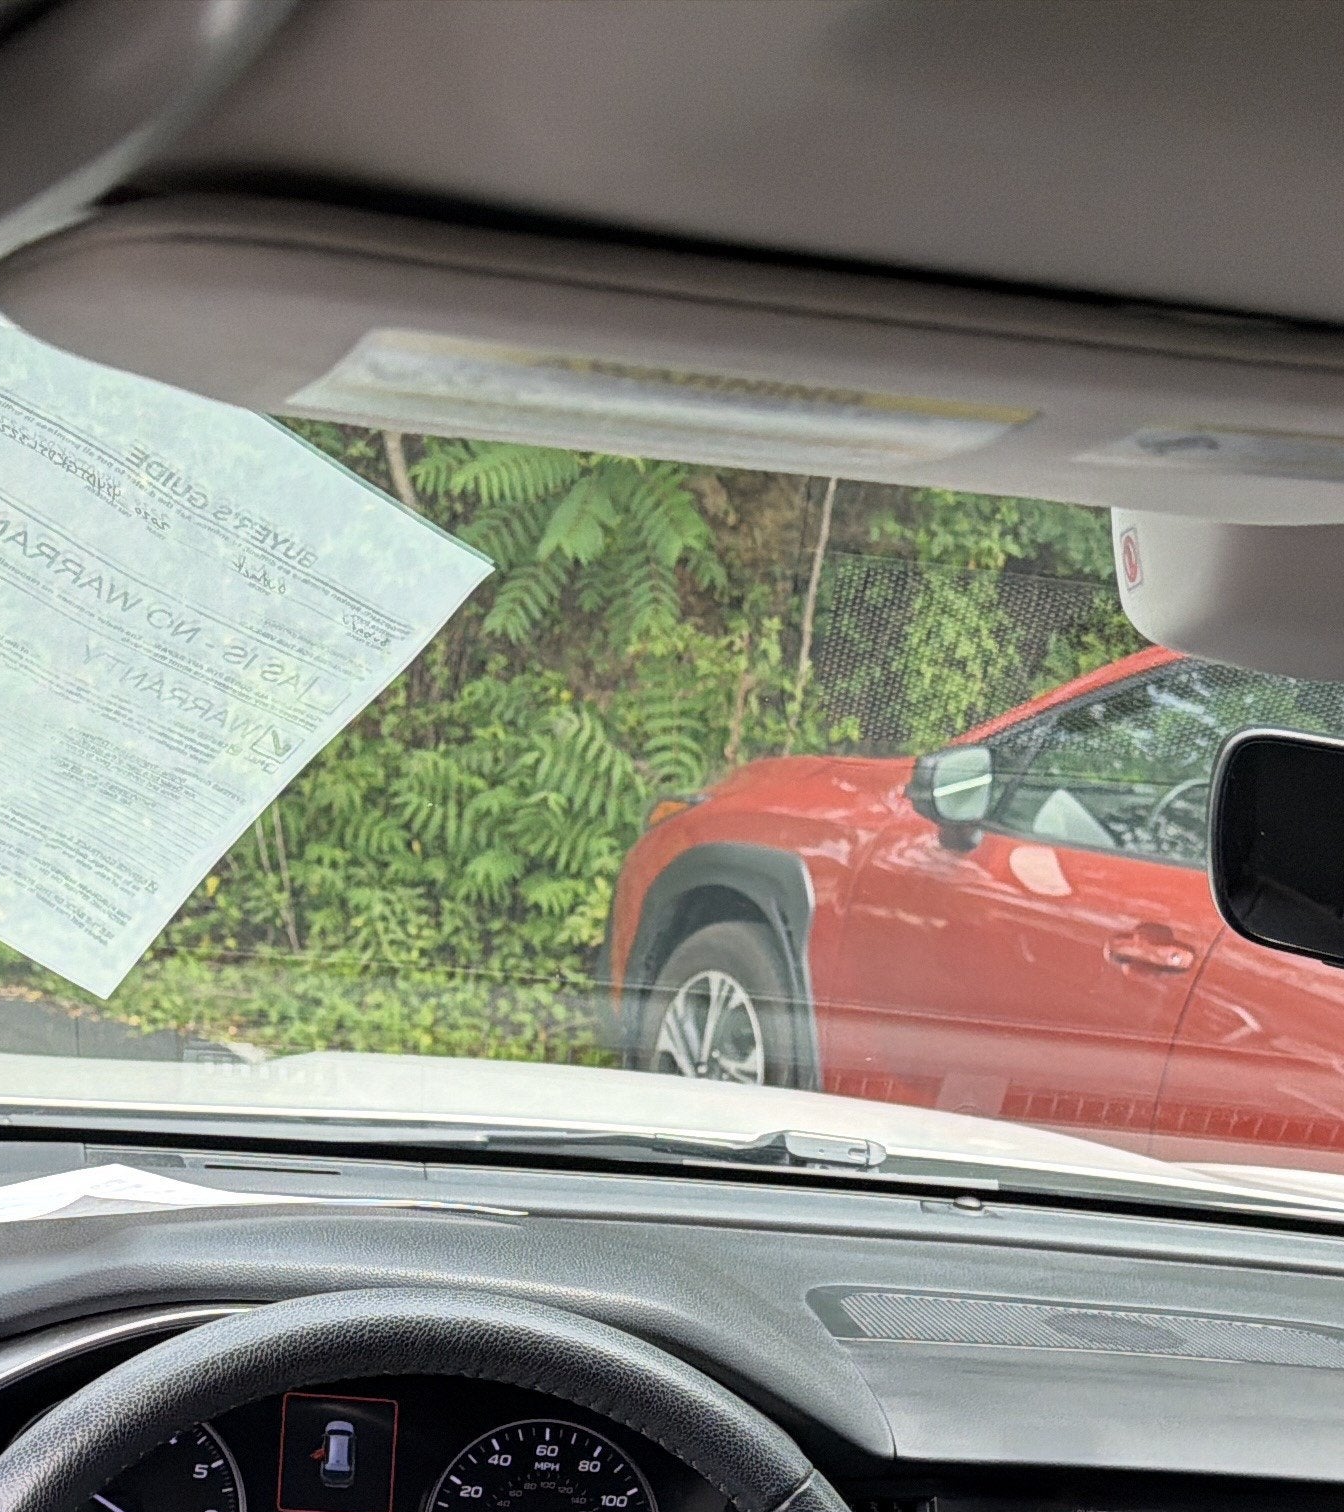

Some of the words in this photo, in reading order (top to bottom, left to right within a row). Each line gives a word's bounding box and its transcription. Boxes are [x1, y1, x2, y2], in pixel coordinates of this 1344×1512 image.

[536, 1445, 558, 1457] 60
[487, 1454, 512, 1466] 40
[192, 1464, 208, 1479] 5
[534, 1462, 560, 1472] MPH
[578, 1461, 601, 1473] 80
[460, 1486, 483, 1498] 20
[600, 1495, 628, 1508] 100
